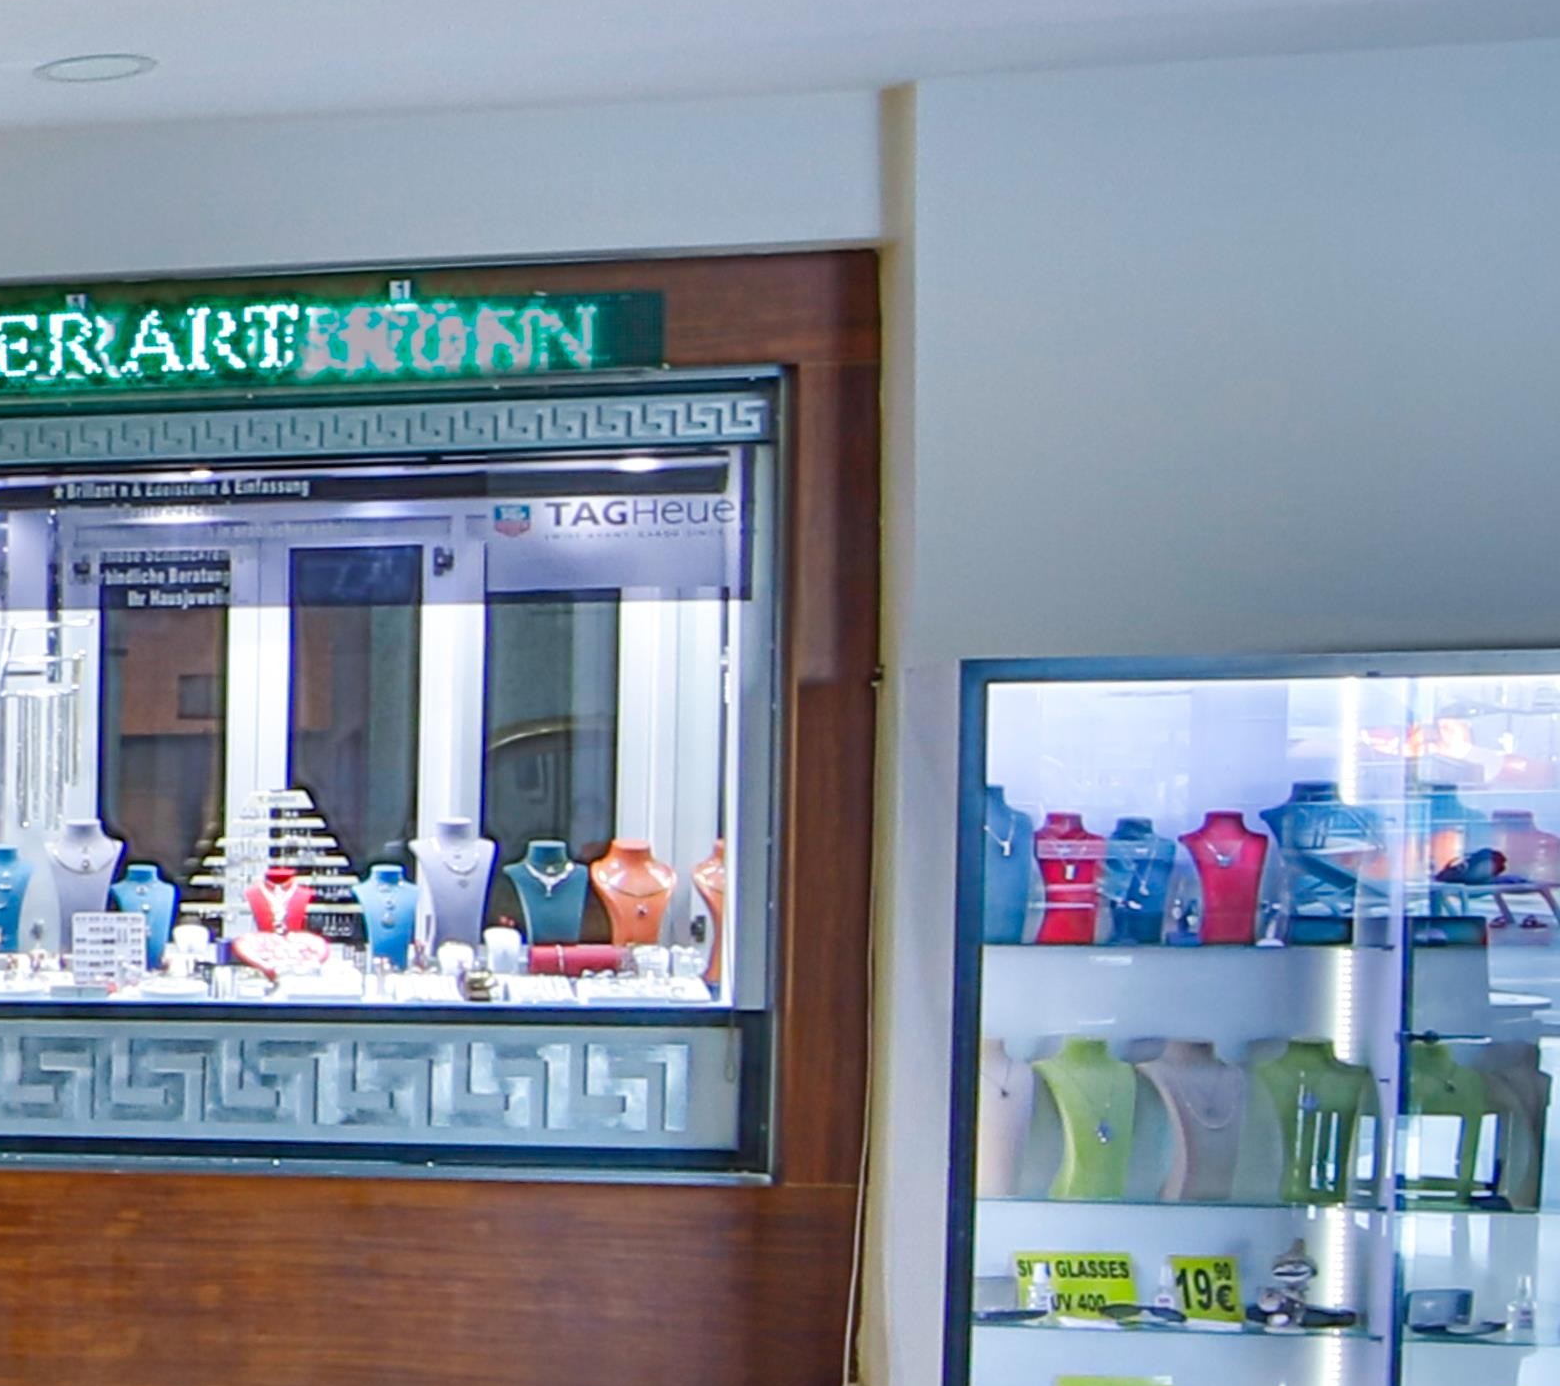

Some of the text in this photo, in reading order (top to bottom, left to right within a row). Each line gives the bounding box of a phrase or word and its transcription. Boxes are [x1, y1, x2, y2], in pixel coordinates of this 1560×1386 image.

[235, 479, 310, 497] Einfassung
[544, 498, 736, 527] TAGHeue
[1055, 1261, 1130, 1279] GLASSES
